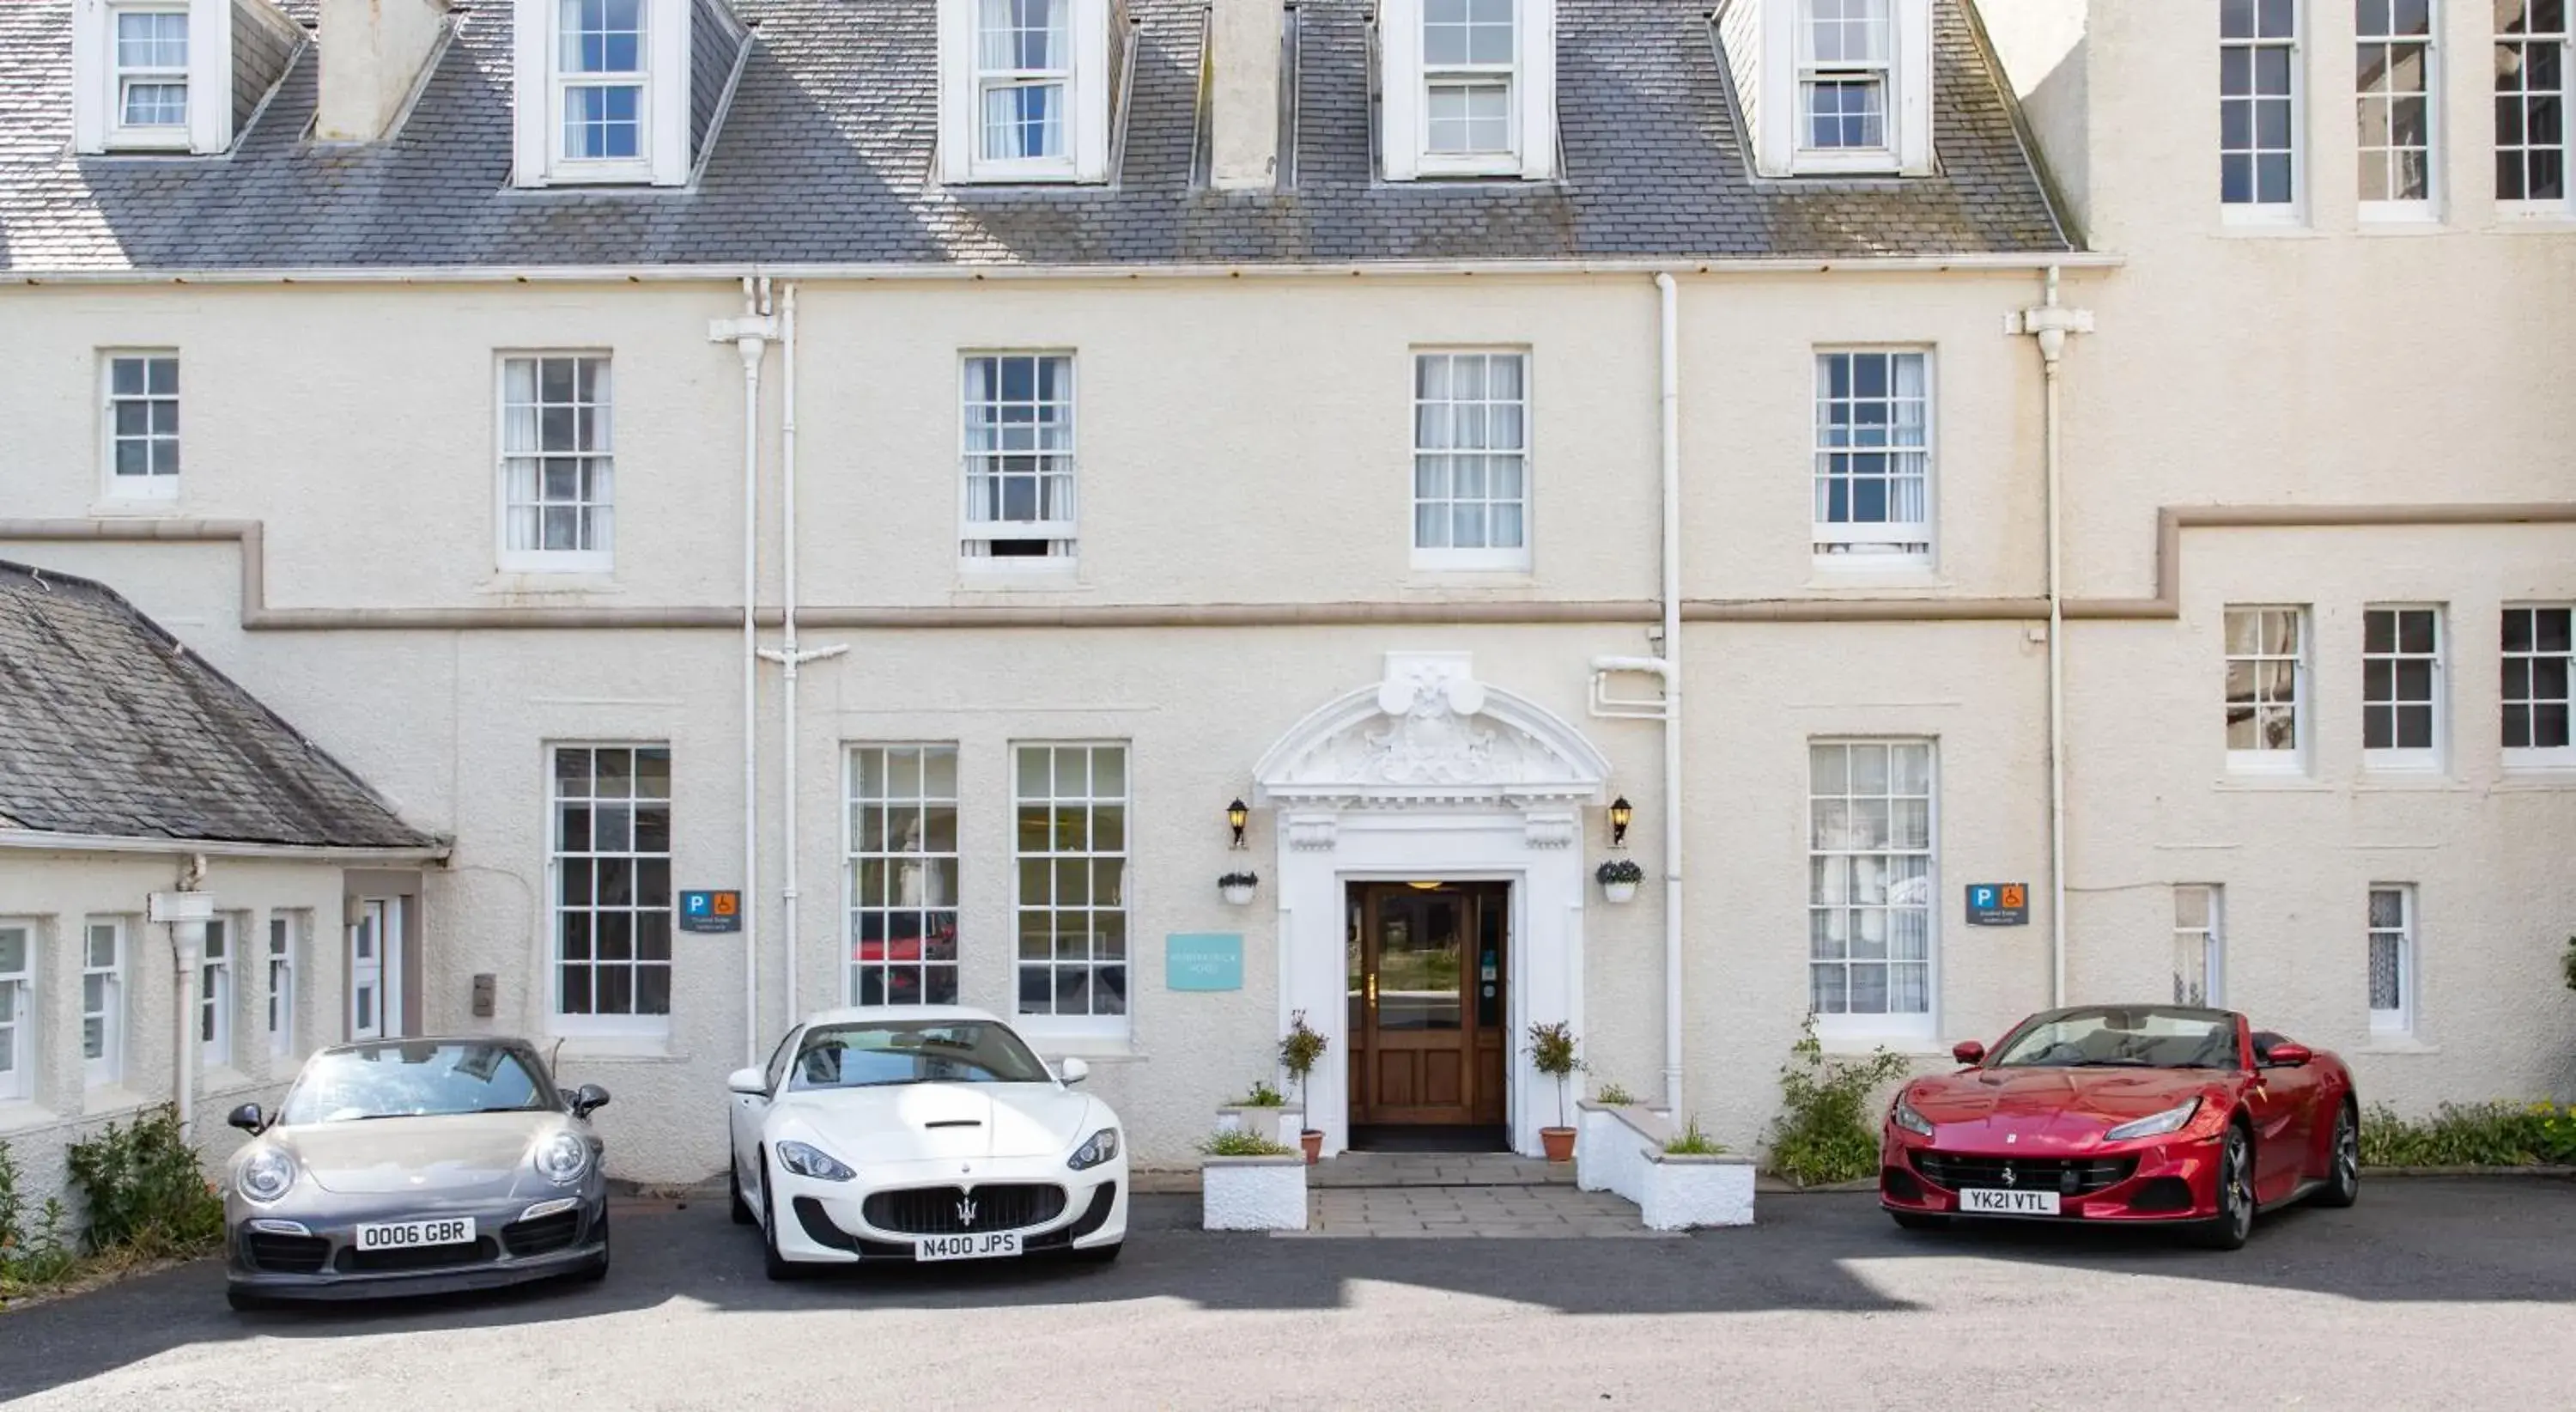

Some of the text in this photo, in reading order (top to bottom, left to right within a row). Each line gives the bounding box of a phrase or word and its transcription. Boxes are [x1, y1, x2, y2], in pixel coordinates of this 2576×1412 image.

[691, 896, 703, 911] P
[1978, 889, 1991, 905] P
[1971, 1190, 2048, 1210] YK21 VTL
[425, 1221, 465, 1241] GBR
[923, 1234, 1014, 1257] N400 JPS
